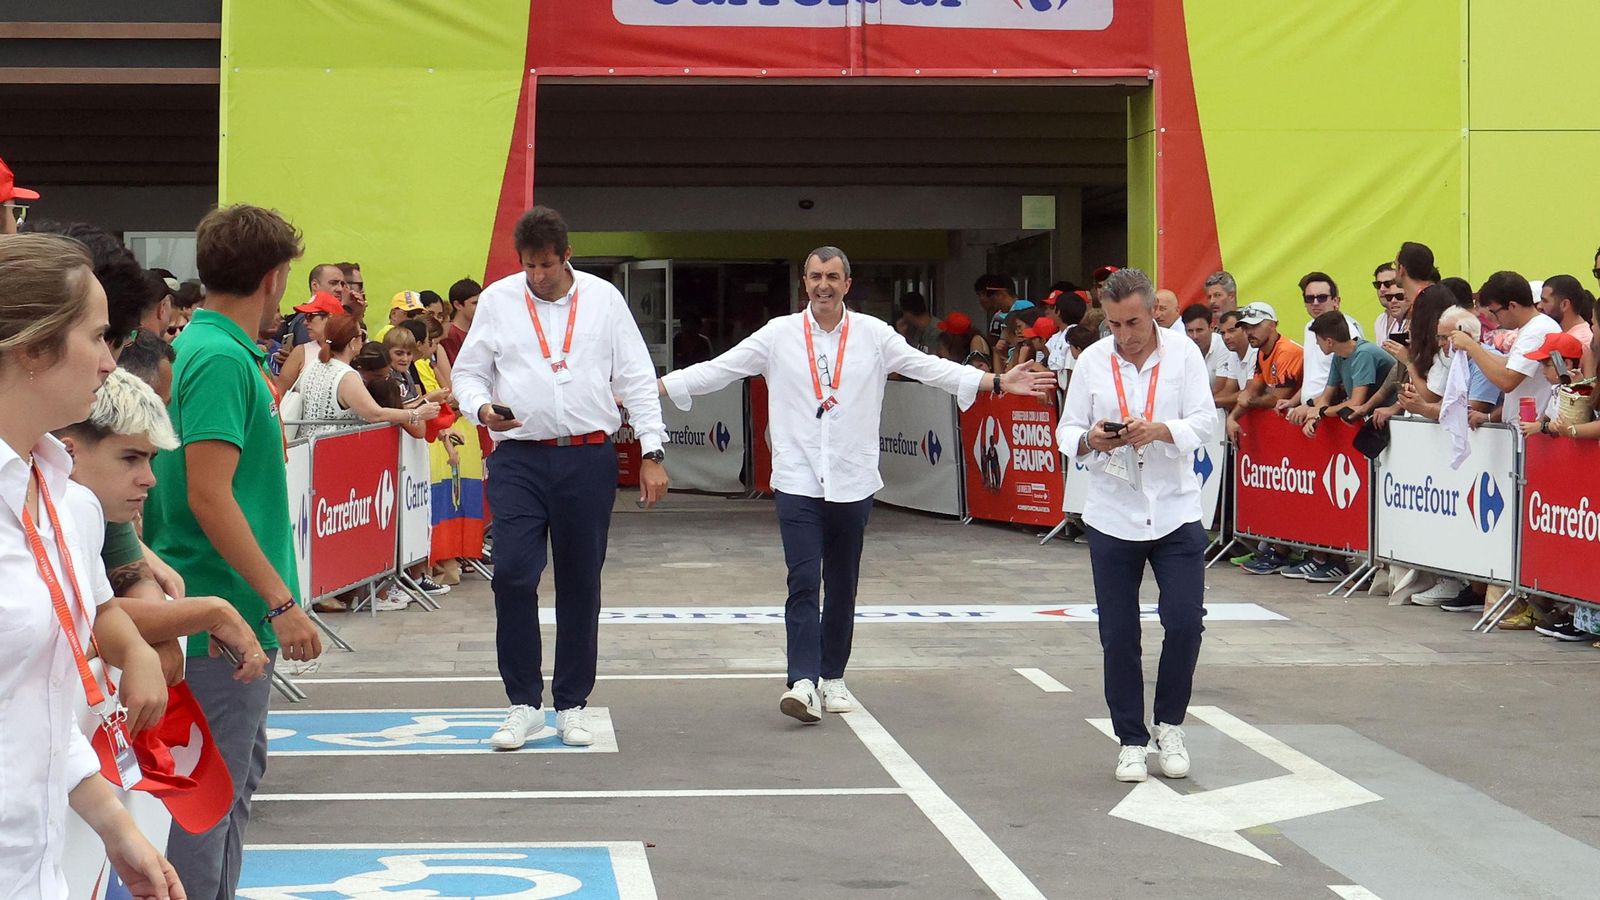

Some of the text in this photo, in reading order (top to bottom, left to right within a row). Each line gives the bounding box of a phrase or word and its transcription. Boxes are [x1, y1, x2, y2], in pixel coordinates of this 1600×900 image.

[665, 425, 705, 445] rrefour
[879, 431, 918, 456] arrefour
[1012, 423, 1052, 447] SOMOS
[1013, 449, 1054, 472] EQUIPO
[1240, 453, 1316, 495] Carrefour
[406, 475, 429, 511] Carre
[1383, 472, 1459, 516] Carrefour
[316, 488, 372, 539] Carrefour
[1528, 490, 1600, 543] Carrefo
